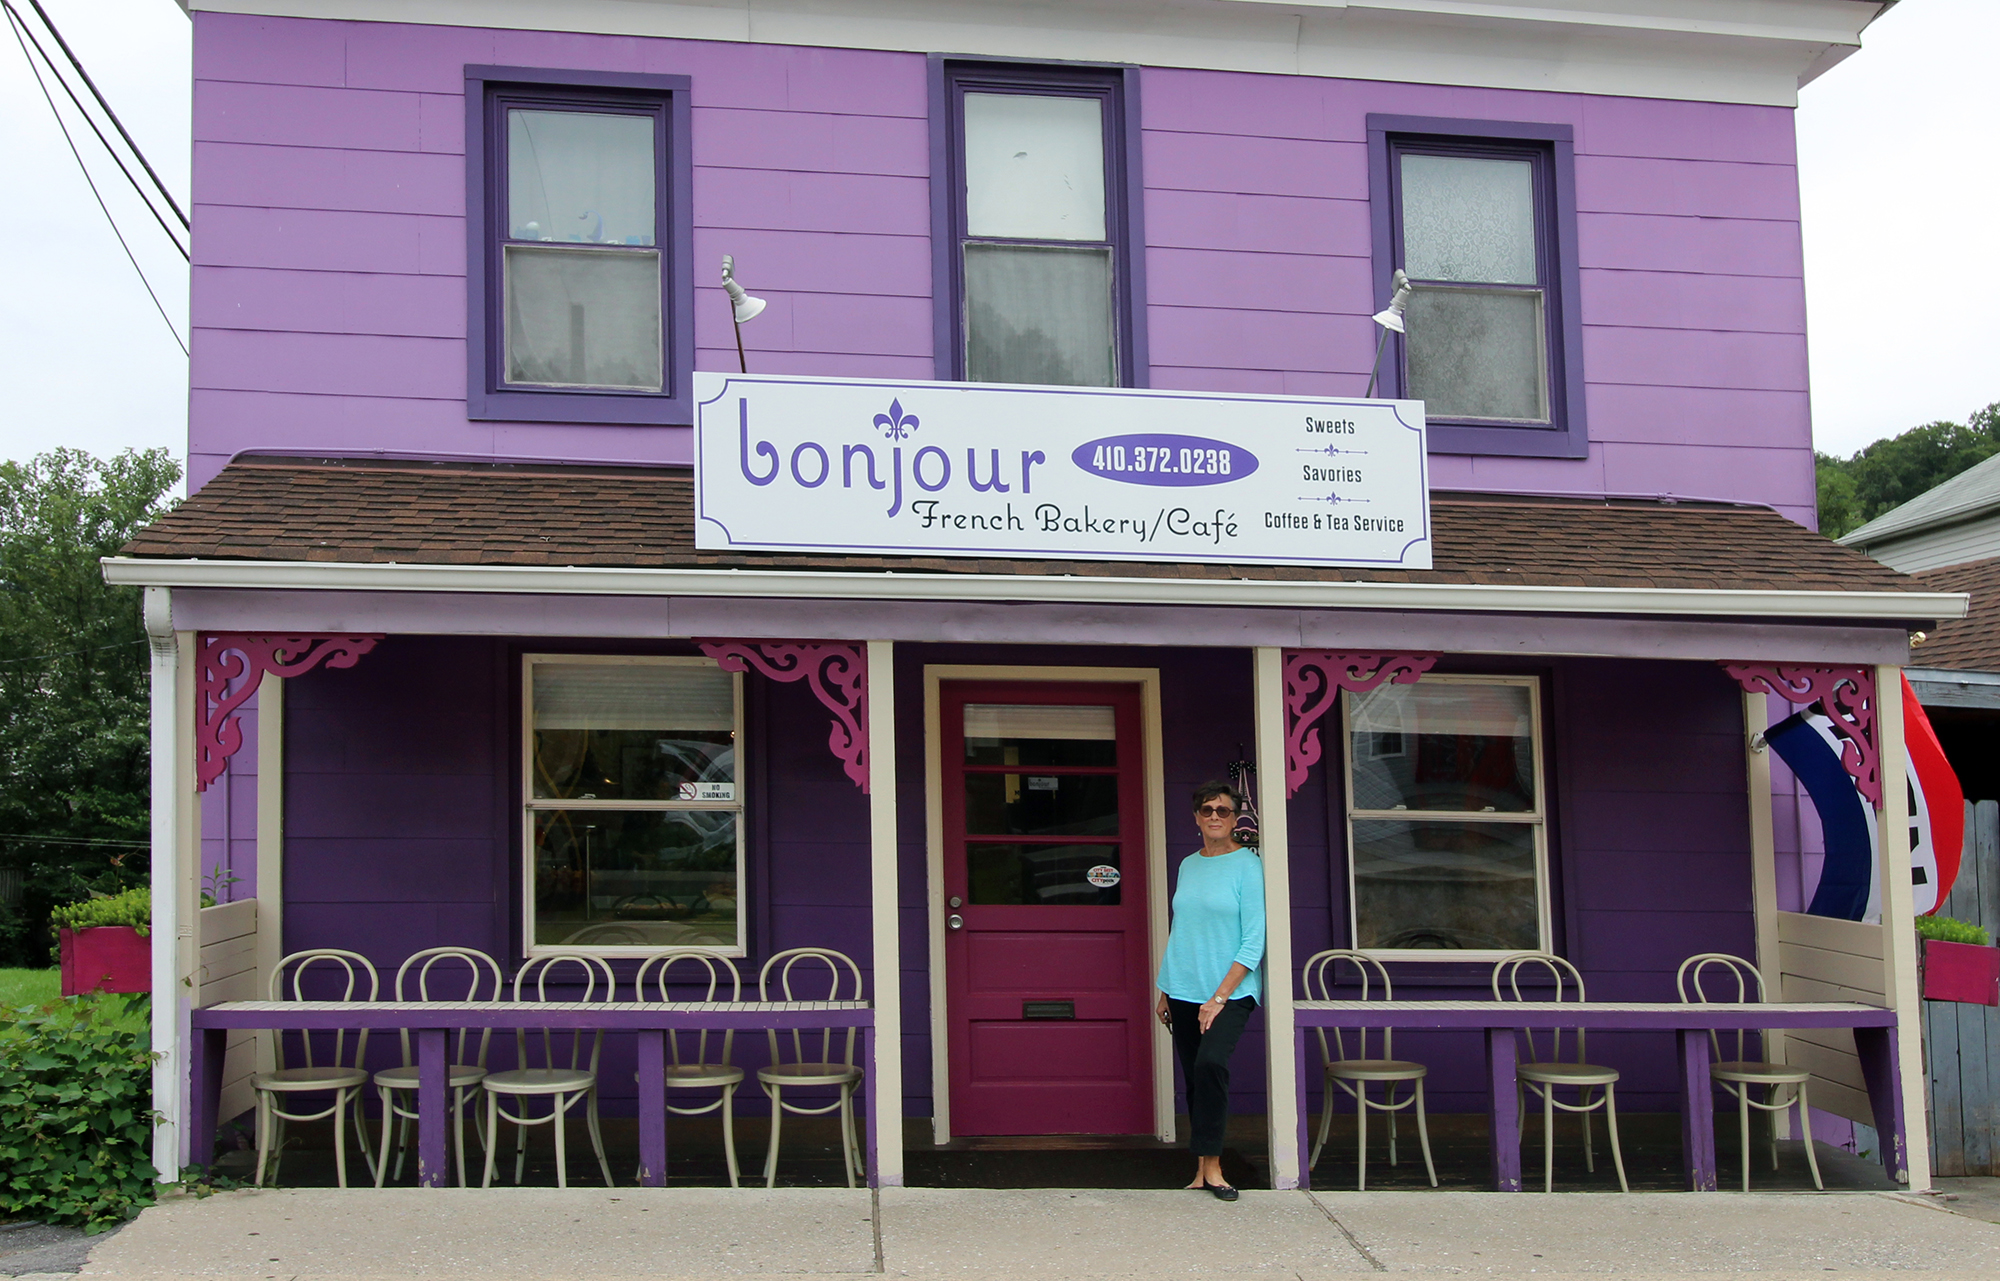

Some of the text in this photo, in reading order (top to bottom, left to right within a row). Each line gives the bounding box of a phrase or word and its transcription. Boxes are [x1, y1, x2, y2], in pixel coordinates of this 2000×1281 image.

[1305, 416, 1355, 435] Sweets
[739, 397, 1046, 518] bonjour
[1092, 445, 1231, 476] 410.372.0238
[1302, 464, 1362, 483] Savories
[911, 500, 1239, 544] French Bakery/Café
[1264, 511, 1405, 533] Coffee & Tea Service
